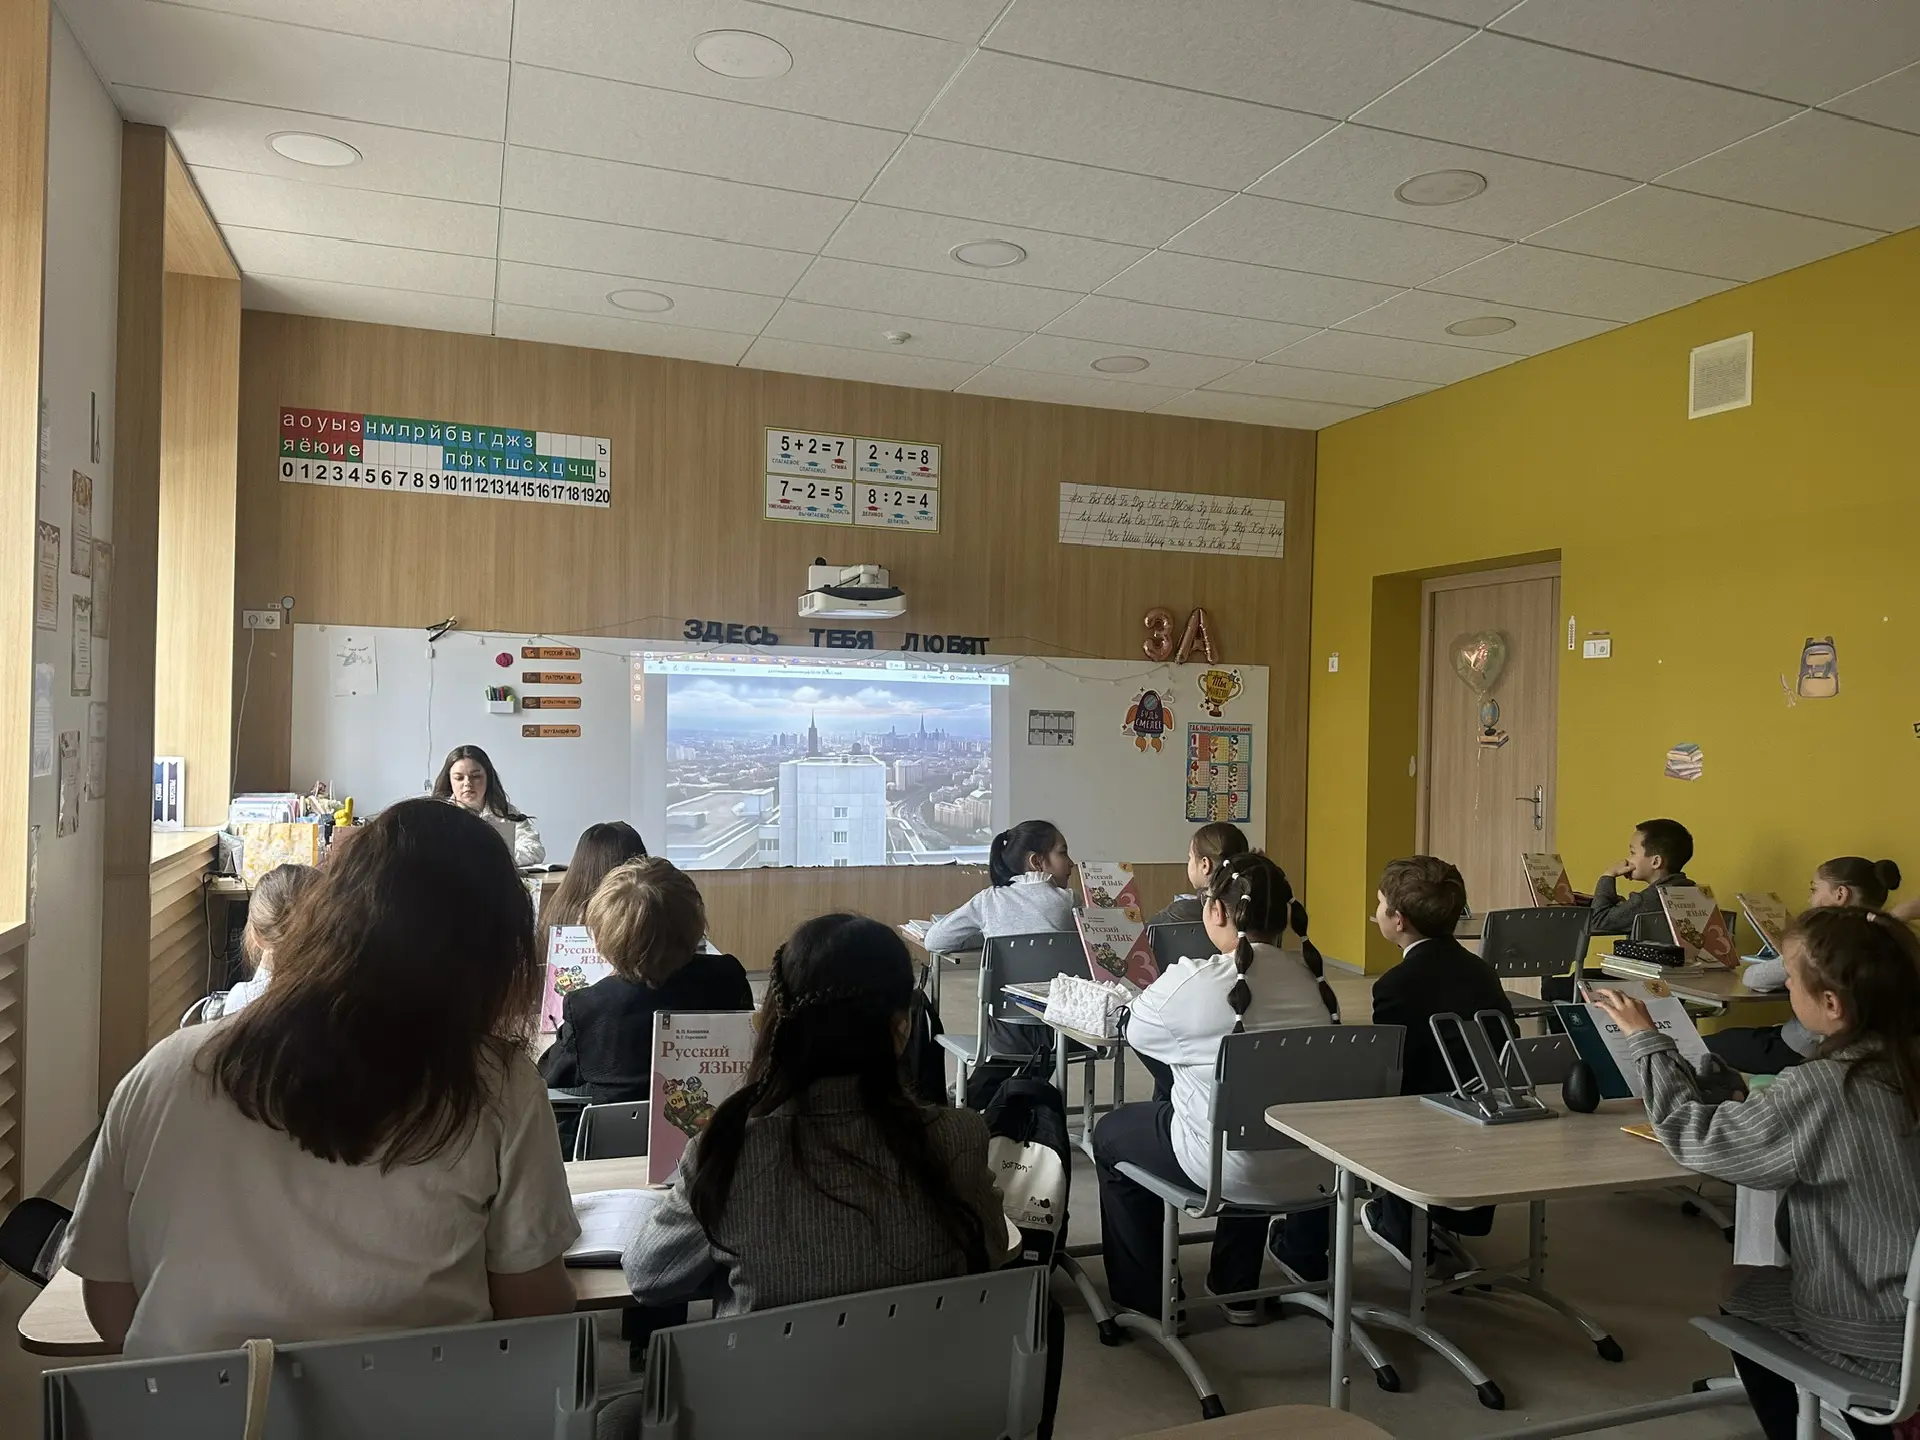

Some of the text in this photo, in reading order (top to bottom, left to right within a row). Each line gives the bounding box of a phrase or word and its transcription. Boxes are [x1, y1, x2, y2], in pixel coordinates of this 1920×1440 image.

[282, 462, 610, 504] 0 1 2 3 4 5 6 7 8 9 10 11 12 13 14 15 16 17 18 19 20
[683, 619, 990, 656] ЗДЕСЬ ТЕБЯ ЛЮБЯТ
[1212, 676, 1227, 688] Ты
[1140, 710, 1158, 720] БУДЬ
[1135, 718, 1162, 729] СМЕЛЕЕ
[1191, 734, 1196, 745] 1
[1211, 736, 1218, 746] 2
[1231, 735, 1239, 745] 3
[1191, 761, 1199, 771] 4
[1211, 765, 1218, 776] 5
[1229, 763, 1237, 773] 6
[1190, 790, 1197, 801] 7
[1210, 794, 1217, 805] 8
[1230, 793, 1238, 803] 9
[1084, 872, 1113, 880] Русский
[1666, 900, 1696, 910] Русский
[1083, 923, 1120, 934] Русский
[1708, 925, 1731, 955] 3
[555, 943, 597, 956] Русски
[1132, 950, 1158, 986] 3
[661, 1041, 730, 1061] Русский
[1028, 1215, 1045, 1223] LOVE
